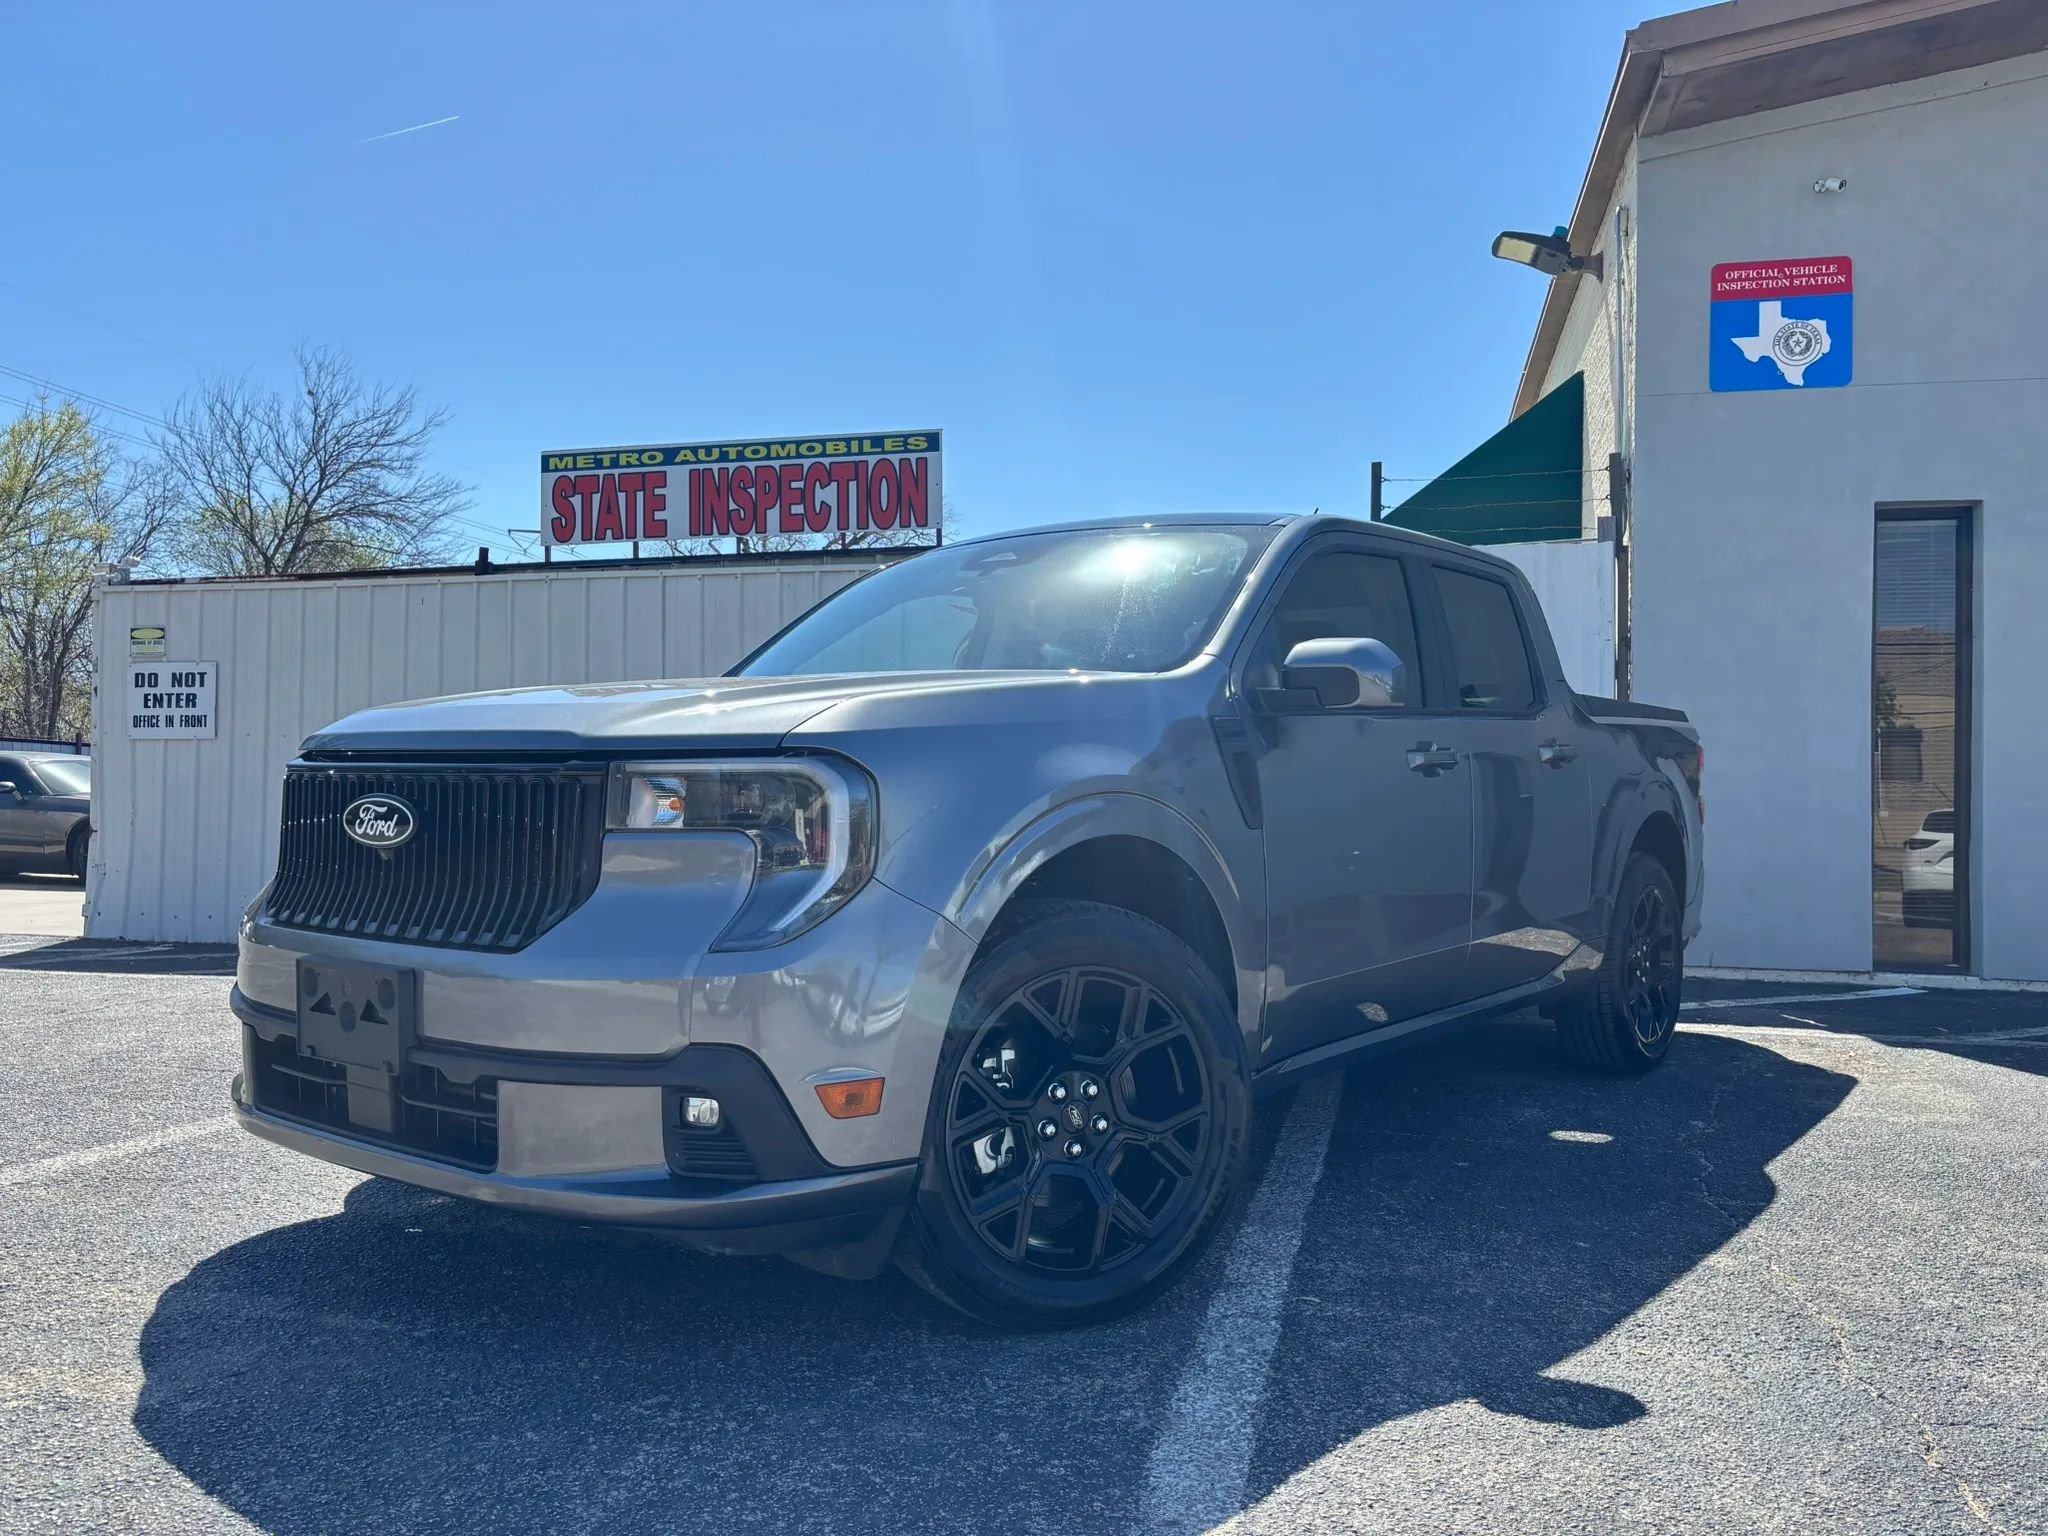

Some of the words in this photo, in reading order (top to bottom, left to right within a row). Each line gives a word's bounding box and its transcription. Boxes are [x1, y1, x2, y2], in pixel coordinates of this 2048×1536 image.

[1725, 269, 1780, 280] OFFICIAL
[1784, 264, 1838, 276] VEHICLE
[1717, 278, 1790, 291] INSPECTION
[1793, 274, 1846, 287] STATION
[548, 451, 664, 470] METRO
[674, 436, 929, 463] AUTOMOBILES
[551, 470, 667, 543] STATE
[689, 457, 928, 537] INSPECTION
[134, 672, 159, 688] DO
[171, 672, 208, 688] NOT
[143, 693, 198, 709] ENTER
[133, 715, 160, 728] OFFICE
[165, 714, 174, 728] IN
[179, 714, 208, 728] FRONT
[355, 804, 398, 837] Ford
